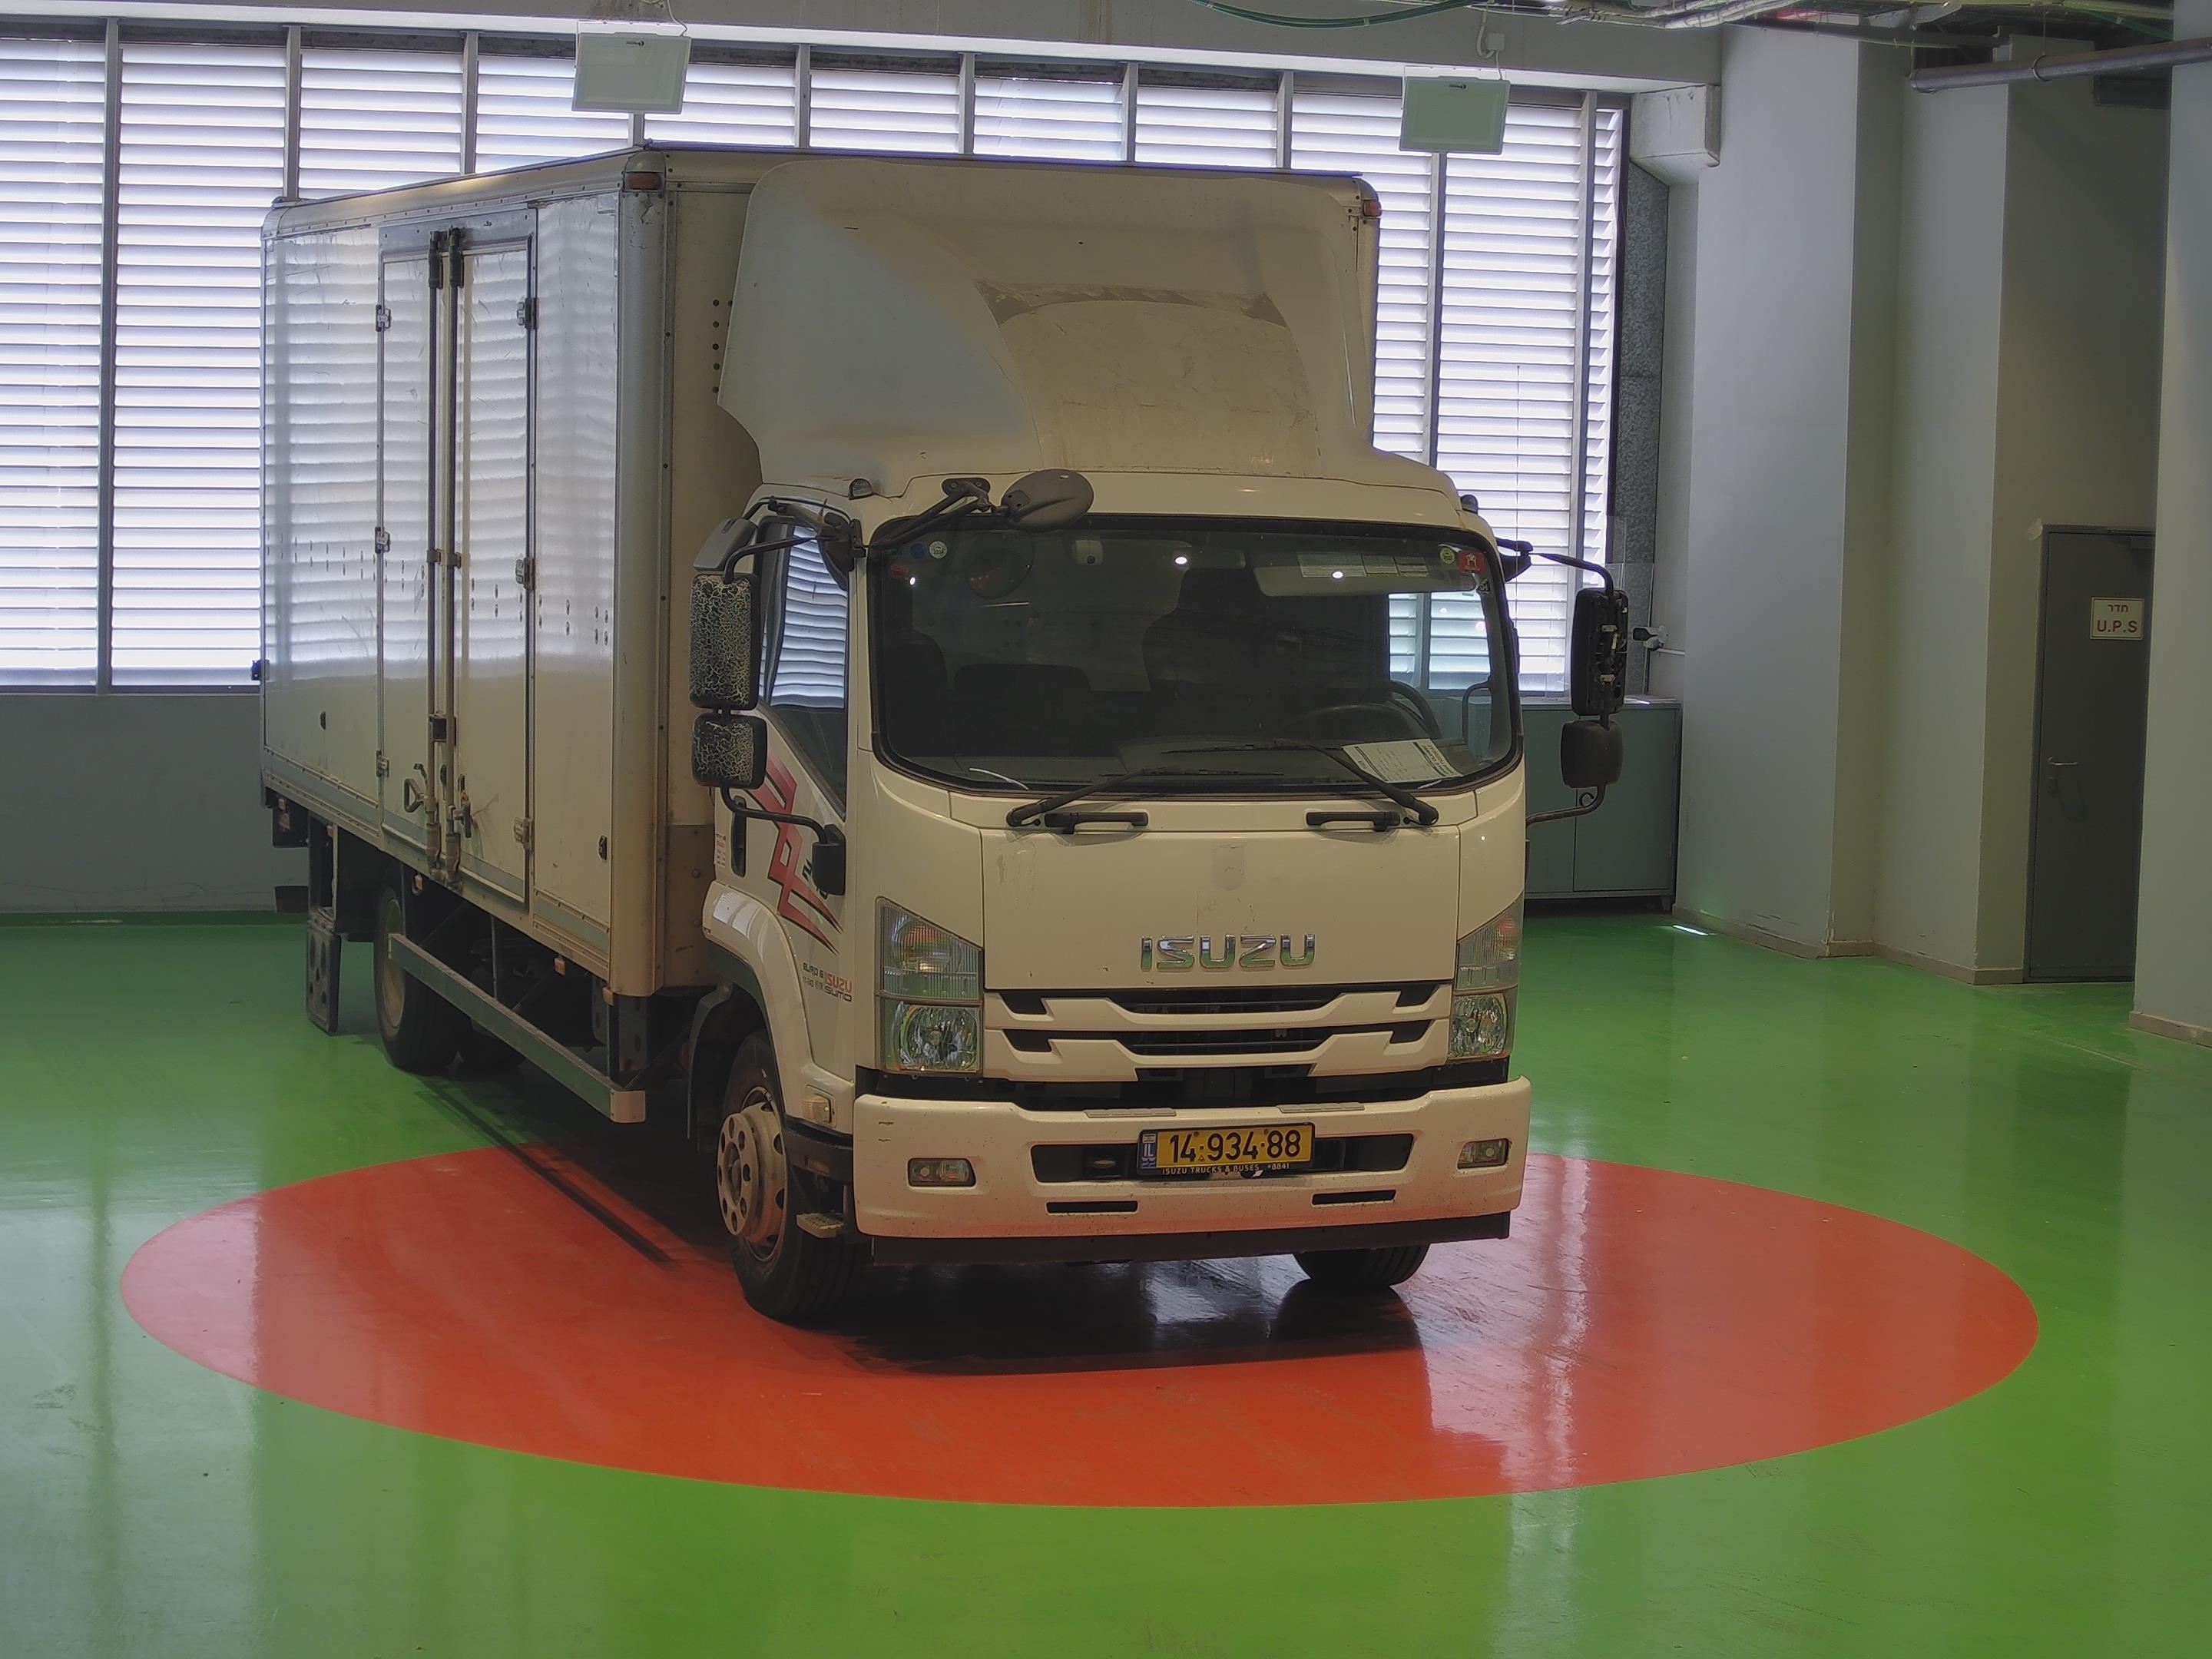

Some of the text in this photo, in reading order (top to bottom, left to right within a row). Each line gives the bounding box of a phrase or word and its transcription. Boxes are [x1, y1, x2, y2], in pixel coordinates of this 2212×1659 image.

[2108, 604, 2128, 613] חדר
[2096, 619, 2137, 633] U.P.S
[1141, 933, 1315, 972] ISUZU
[824, 972, 852, 994] ISUZU
[824, 985, 853, 1002] SUMO
[1162, 1167, 1187, 1175] ISUZU
[1190, 1165, 1222, 1174] TRUCKS
[1233, 1164, 1260, 1172] BUSES
